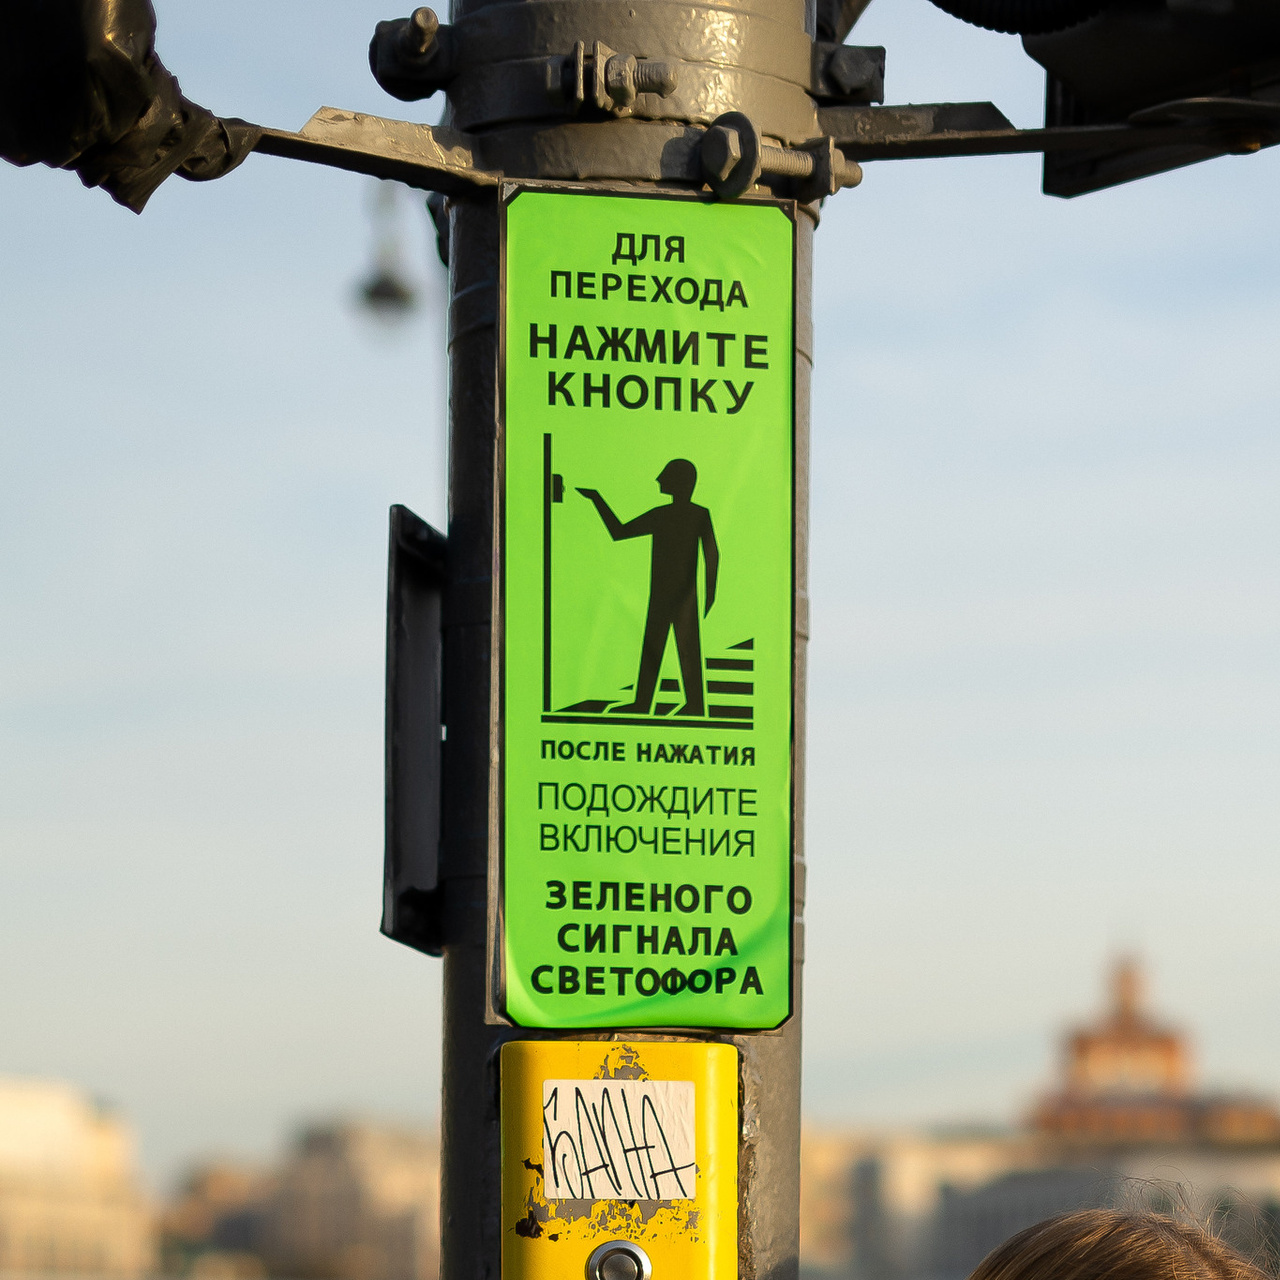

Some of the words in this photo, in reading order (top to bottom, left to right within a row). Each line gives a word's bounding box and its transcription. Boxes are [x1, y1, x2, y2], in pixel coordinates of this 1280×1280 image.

[611, 232, 685, 267] ДЛЯ
[550, 270, 749, 313] ПЕРЕХОДА
[529, 322, 769, 370] НАЖМИТЕ
[548, 371, 754, 415] КНОПКУ
[541, 739, 626, 762] ПОСЛЕ
[637, 742, 755, 766] НАЖАТИЯ
[538, 782, 758, 820] ПОДОЖДИТЕ
[540, 823, 755, 857] ВКЛЮЧЕНИЯ
[545, 880, 752, 915] ЗЕЛЕНОГО
[557, 923, 739, 957] СИГНАЛА
[530, 964, 764, 997] СВЕТОФОРА
